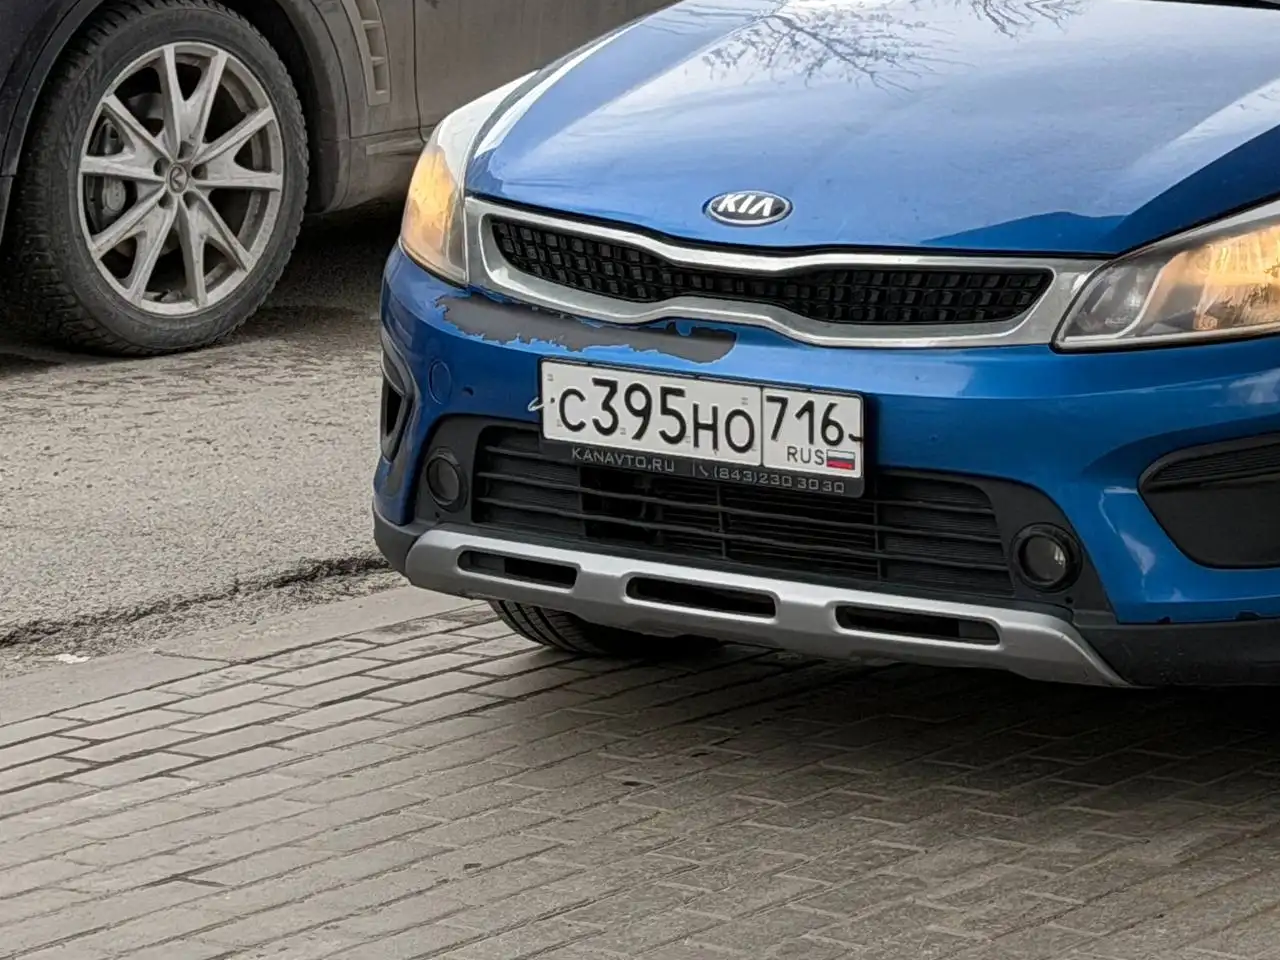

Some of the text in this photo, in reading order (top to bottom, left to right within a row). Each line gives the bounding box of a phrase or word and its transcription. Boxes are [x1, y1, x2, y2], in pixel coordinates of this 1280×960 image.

[718, 194, 775, 217] KIA
[766, 396, 844, 447] 716
[571, 447, 675, 472] KANAVTO.RU
[787, 446, 825, 466] RUS
